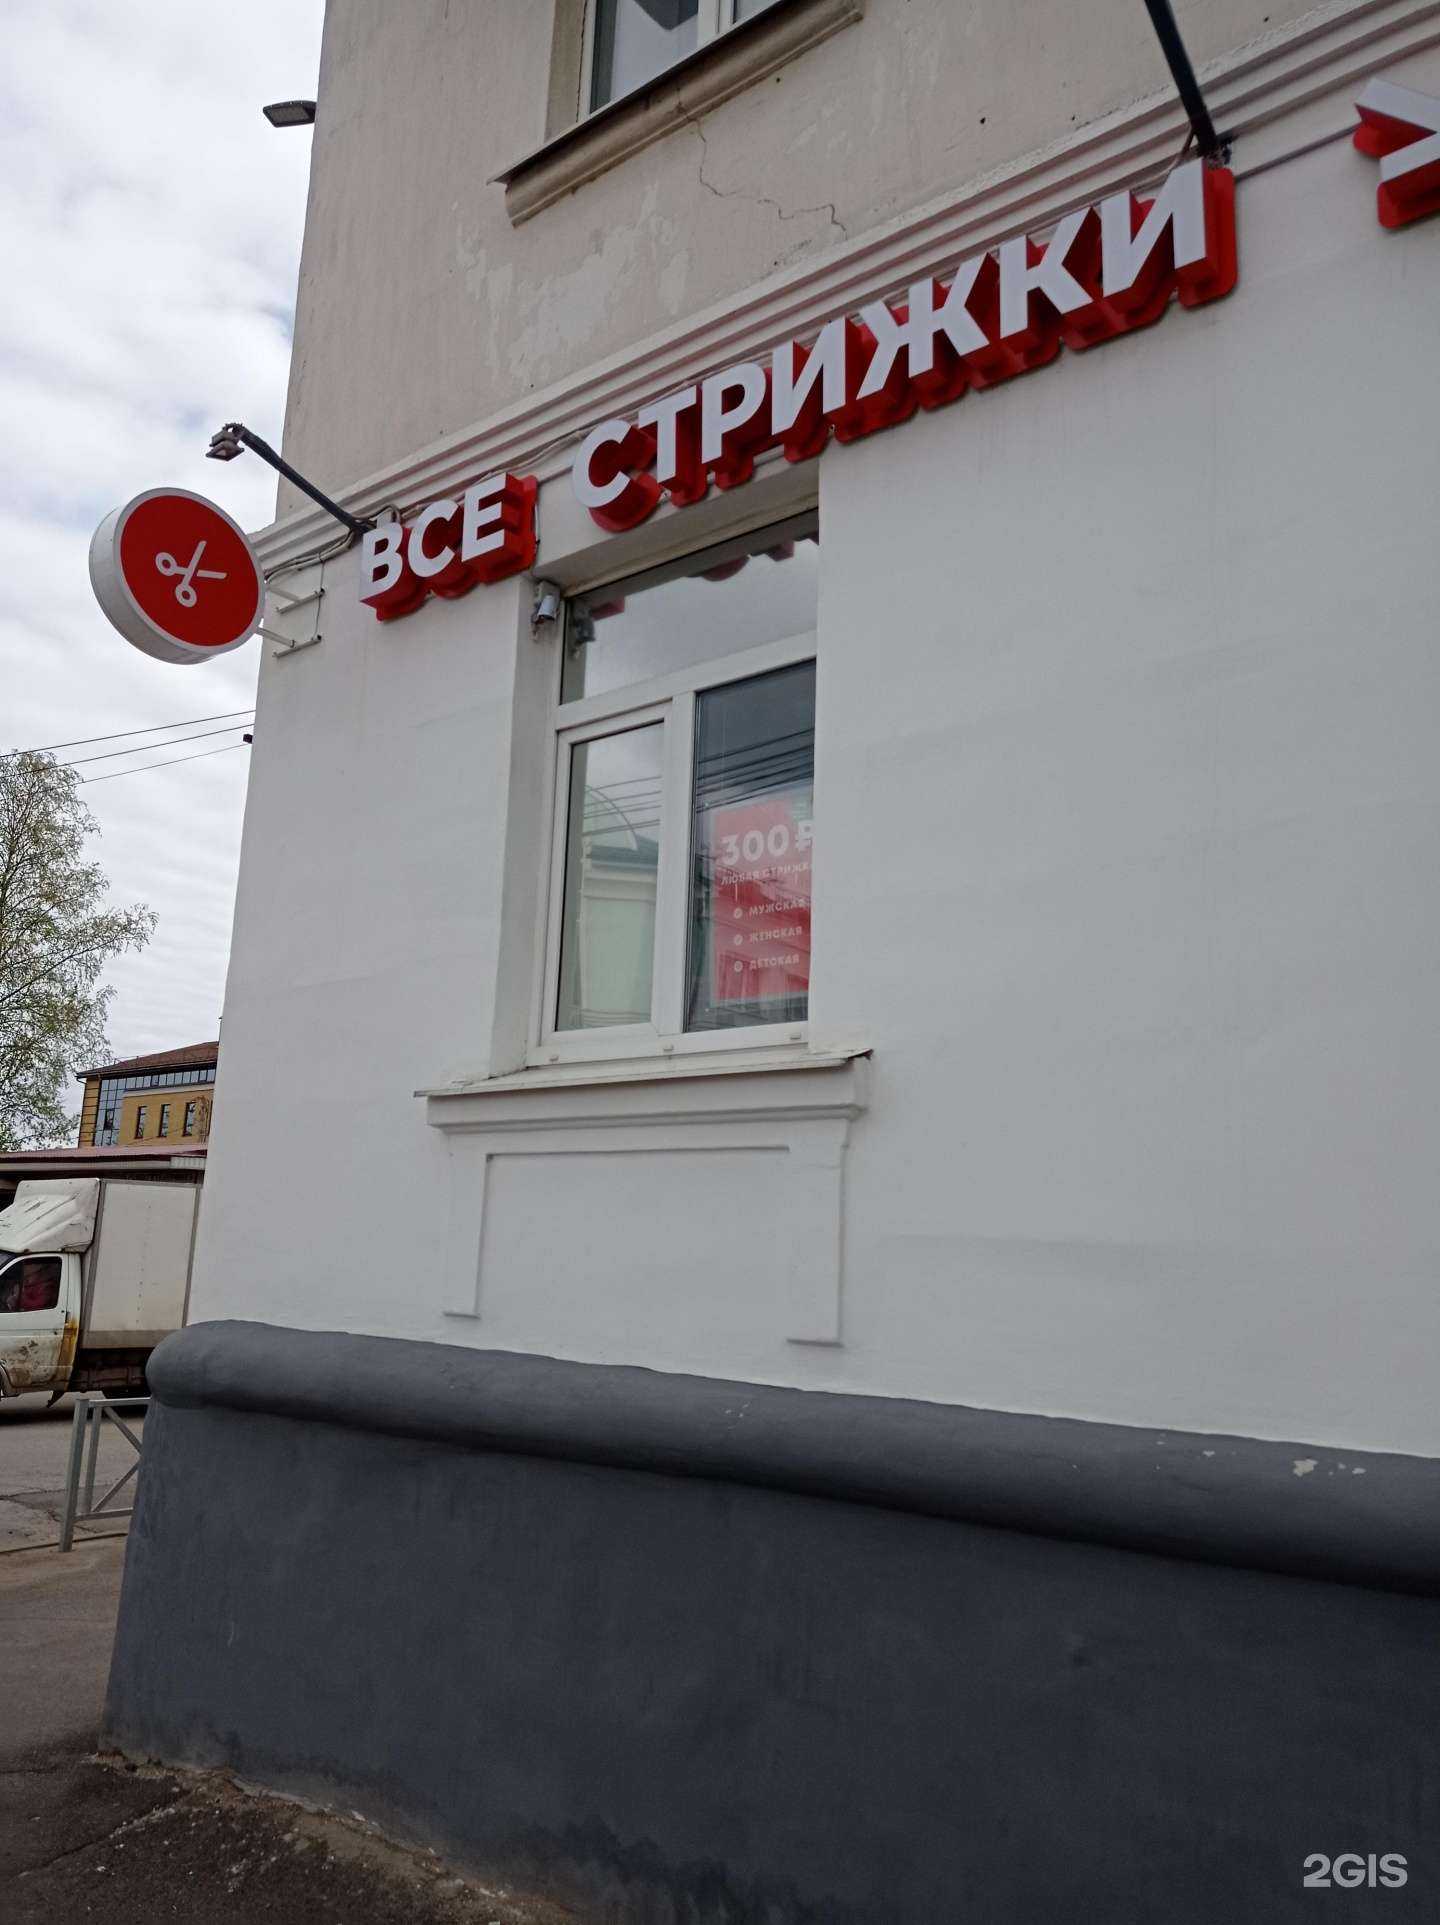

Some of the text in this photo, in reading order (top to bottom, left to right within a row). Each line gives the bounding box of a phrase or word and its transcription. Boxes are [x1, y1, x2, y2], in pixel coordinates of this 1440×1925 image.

[361, 158, 1208, 603] ВСЕ СТРИЖКИ
[762, 863, 812, 879] СТРИЖК
[748, 898, 808, 917] МУЖСКАЯ
[748, 926, 803, 945] ЖЕНСКАЯ
[749, 953, 800, 971] ДЕТСКАЯ
